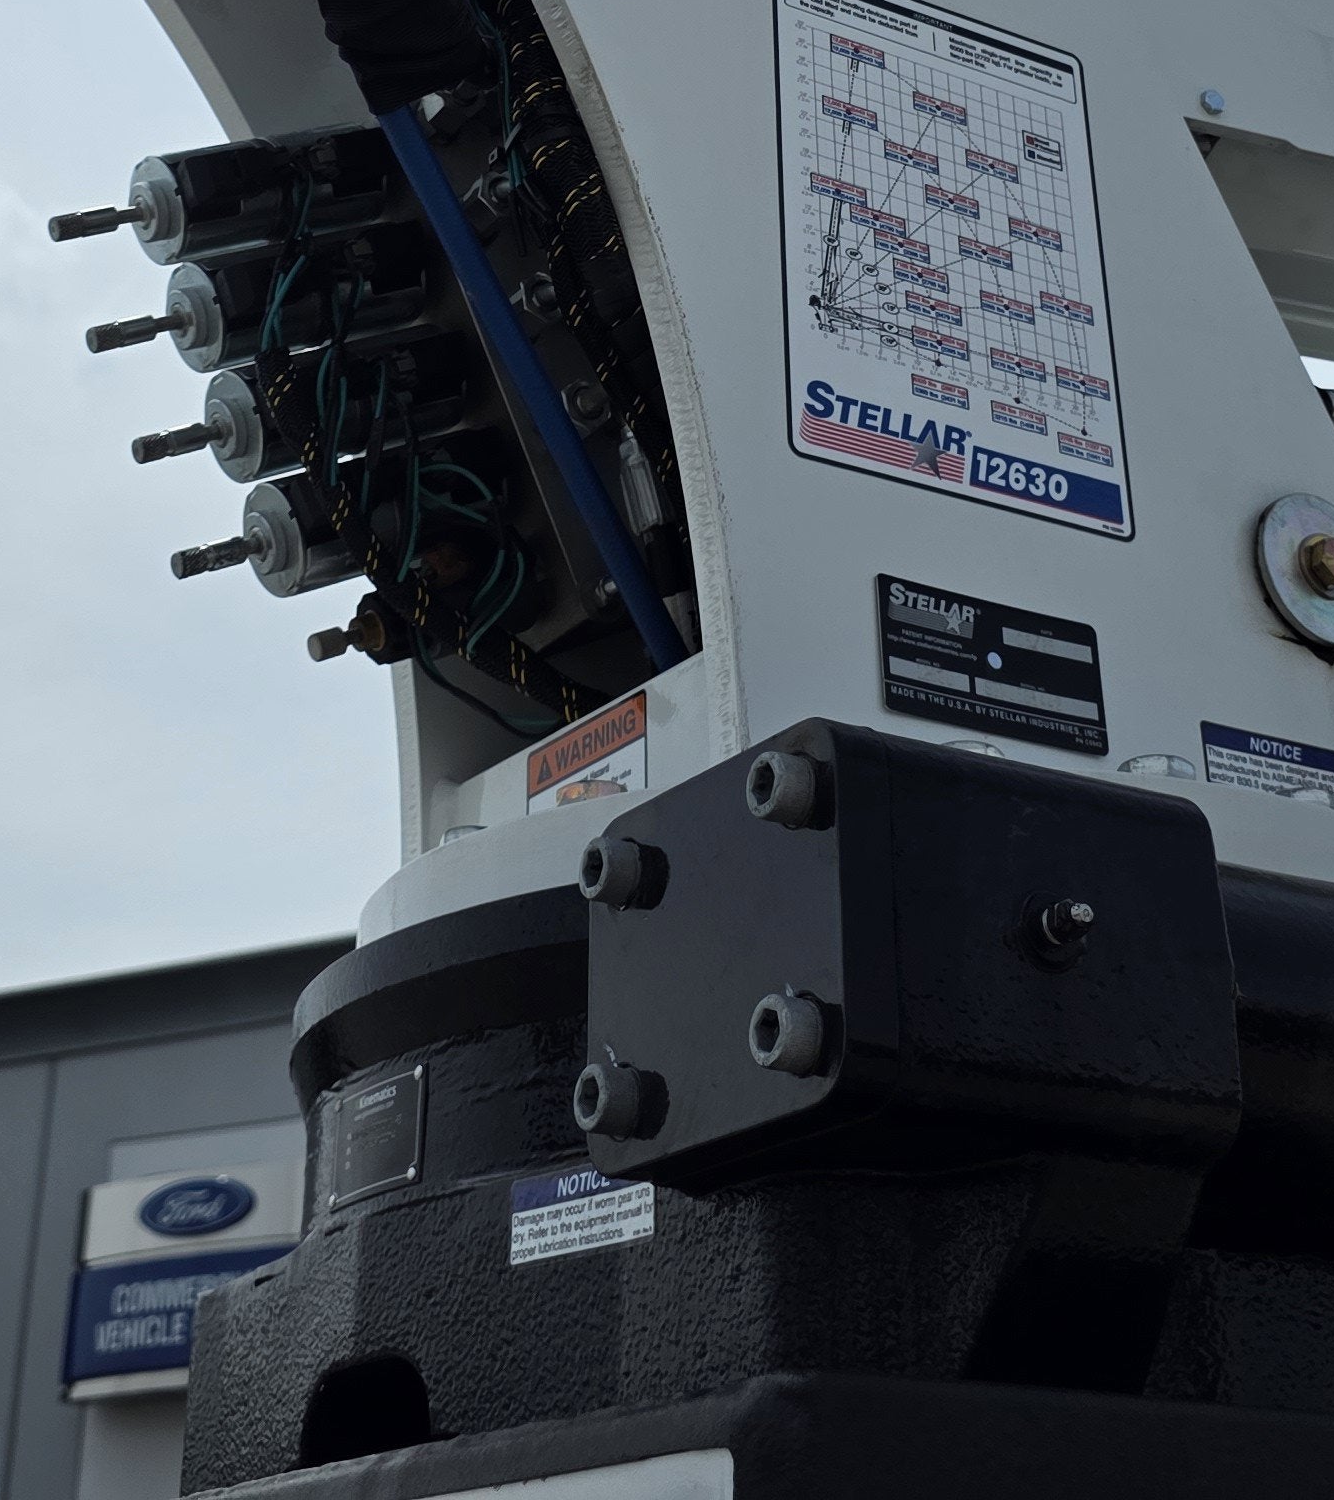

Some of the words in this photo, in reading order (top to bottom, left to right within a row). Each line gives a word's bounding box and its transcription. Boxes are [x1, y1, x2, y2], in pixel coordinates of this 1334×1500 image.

[804, 380, 966, 456] STELLAR
[975, 452, 1069, 502] 12630
[888, 581, 974, 622] STELLAR
[890, 686, 913, 697] MADE
[917, 691, 925, 701] IN
[928, 694, 944, 704] THE
[948, 698, 971, 711] U.S.A.
[975, 704, 986, 715] BY
[990, 708, 1025, 723] STELLAR
[1084, 729, 1101, 739] INC.
[554, 708, 637, 772] WARNING
[1249, 736, 1302, 761] NOTICE
[1208, 747, 1223, 757] This
[1225, 752, 1247, 763] crane
[1249, 756, 1263, 766] has
[1264, 760, 1283, 771] been
[1285, 765, 1318, 780] designed
[1320, 772, 1334, 782] and
[1209, 758, 1260, 777] manufactured
[156, 1187, 228, 1225] Ford
[512, 1232, 526, 1245] dry.
[528, 1225, 548, 1239] Refer
[550, 1224, 557, 1235] to
[559, 1221, 571, 1232] the
[575, 1212, 613, 1233] equipment
[617, 1204, 640, 1219] manual
[643, 1201, 653, 1213] for
[514, 1210, 543, 1229] Damage
[546, 1208, 562, 1222] may
[564, 1203, 586, 1215] occur
[594, 1197, 615, 1208] worm
[617, 1192, 632, 1207] gear
[634, 1187, 649, 1198] runs
[511, 1246, 535, 1260] proper
[538, 1236, 574, 1253] lubrication
[579, 1226, 622, 1245] instructions.
[94, 1311, 187, 1352] VEHICLE
